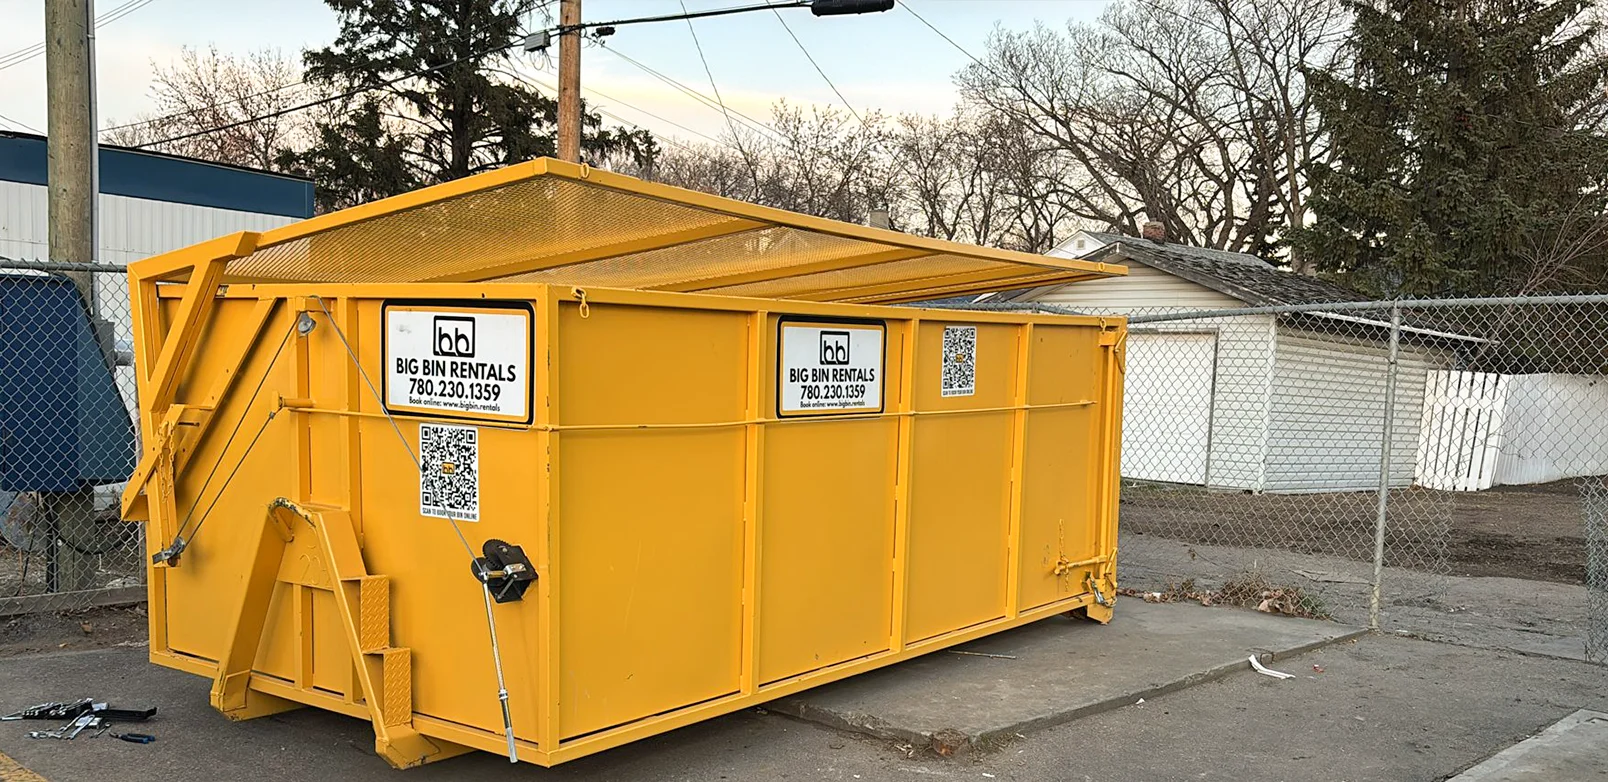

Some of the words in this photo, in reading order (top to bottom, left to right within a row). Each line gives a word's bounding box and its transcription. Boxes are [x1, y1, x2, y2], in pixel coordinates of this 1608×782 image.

[396, 358, 418, 375] BIG
[422, 359, 446, 377] BIN
[450, 361, 516, 382] RENTALS
[789, 368, 809, 382] BIG
[811, 368, 829, 382] BIN
[832, 368, 875, 382] RENTALS
[409, 378, 501, 401] 780.230.1359
[800, 384, 866, 399] 780.230.1359
[409, 396, 422, 405] Book
[423, 397, 442, 406] online:
[443, 400, 501, 412] www.bigbin.rentals
